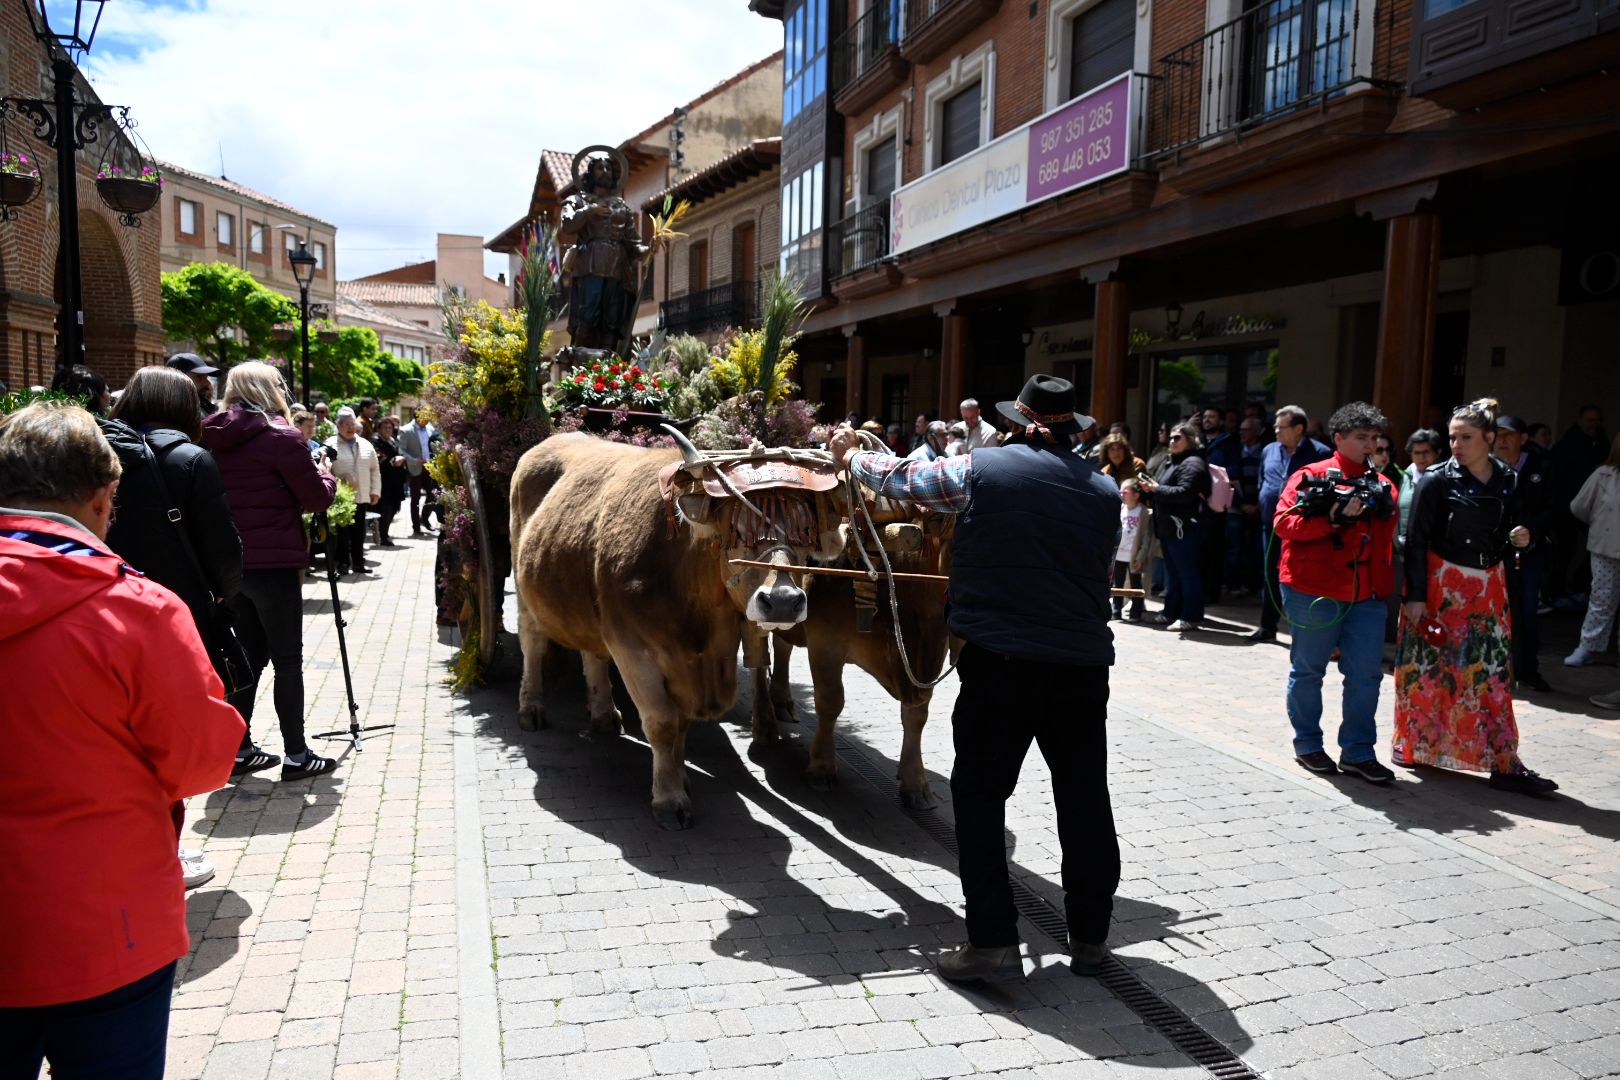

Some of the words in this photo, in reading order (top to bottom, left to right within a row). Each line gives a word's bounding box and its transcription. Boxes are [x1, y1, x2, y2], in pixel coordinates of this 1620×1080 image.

[1041, 126, 1062, 154] 987
[1065, 115, 1084, 143] 351
[1088, 101, 1113, 133] 285
[1038, 158, 1060, 185] 689
[1062, 148, 1083, 174] 448
[1087, 135, 1111, 166] 053
[943, 177, 980, 214] Dental
[984, 163, 1021, 198] Plaza
